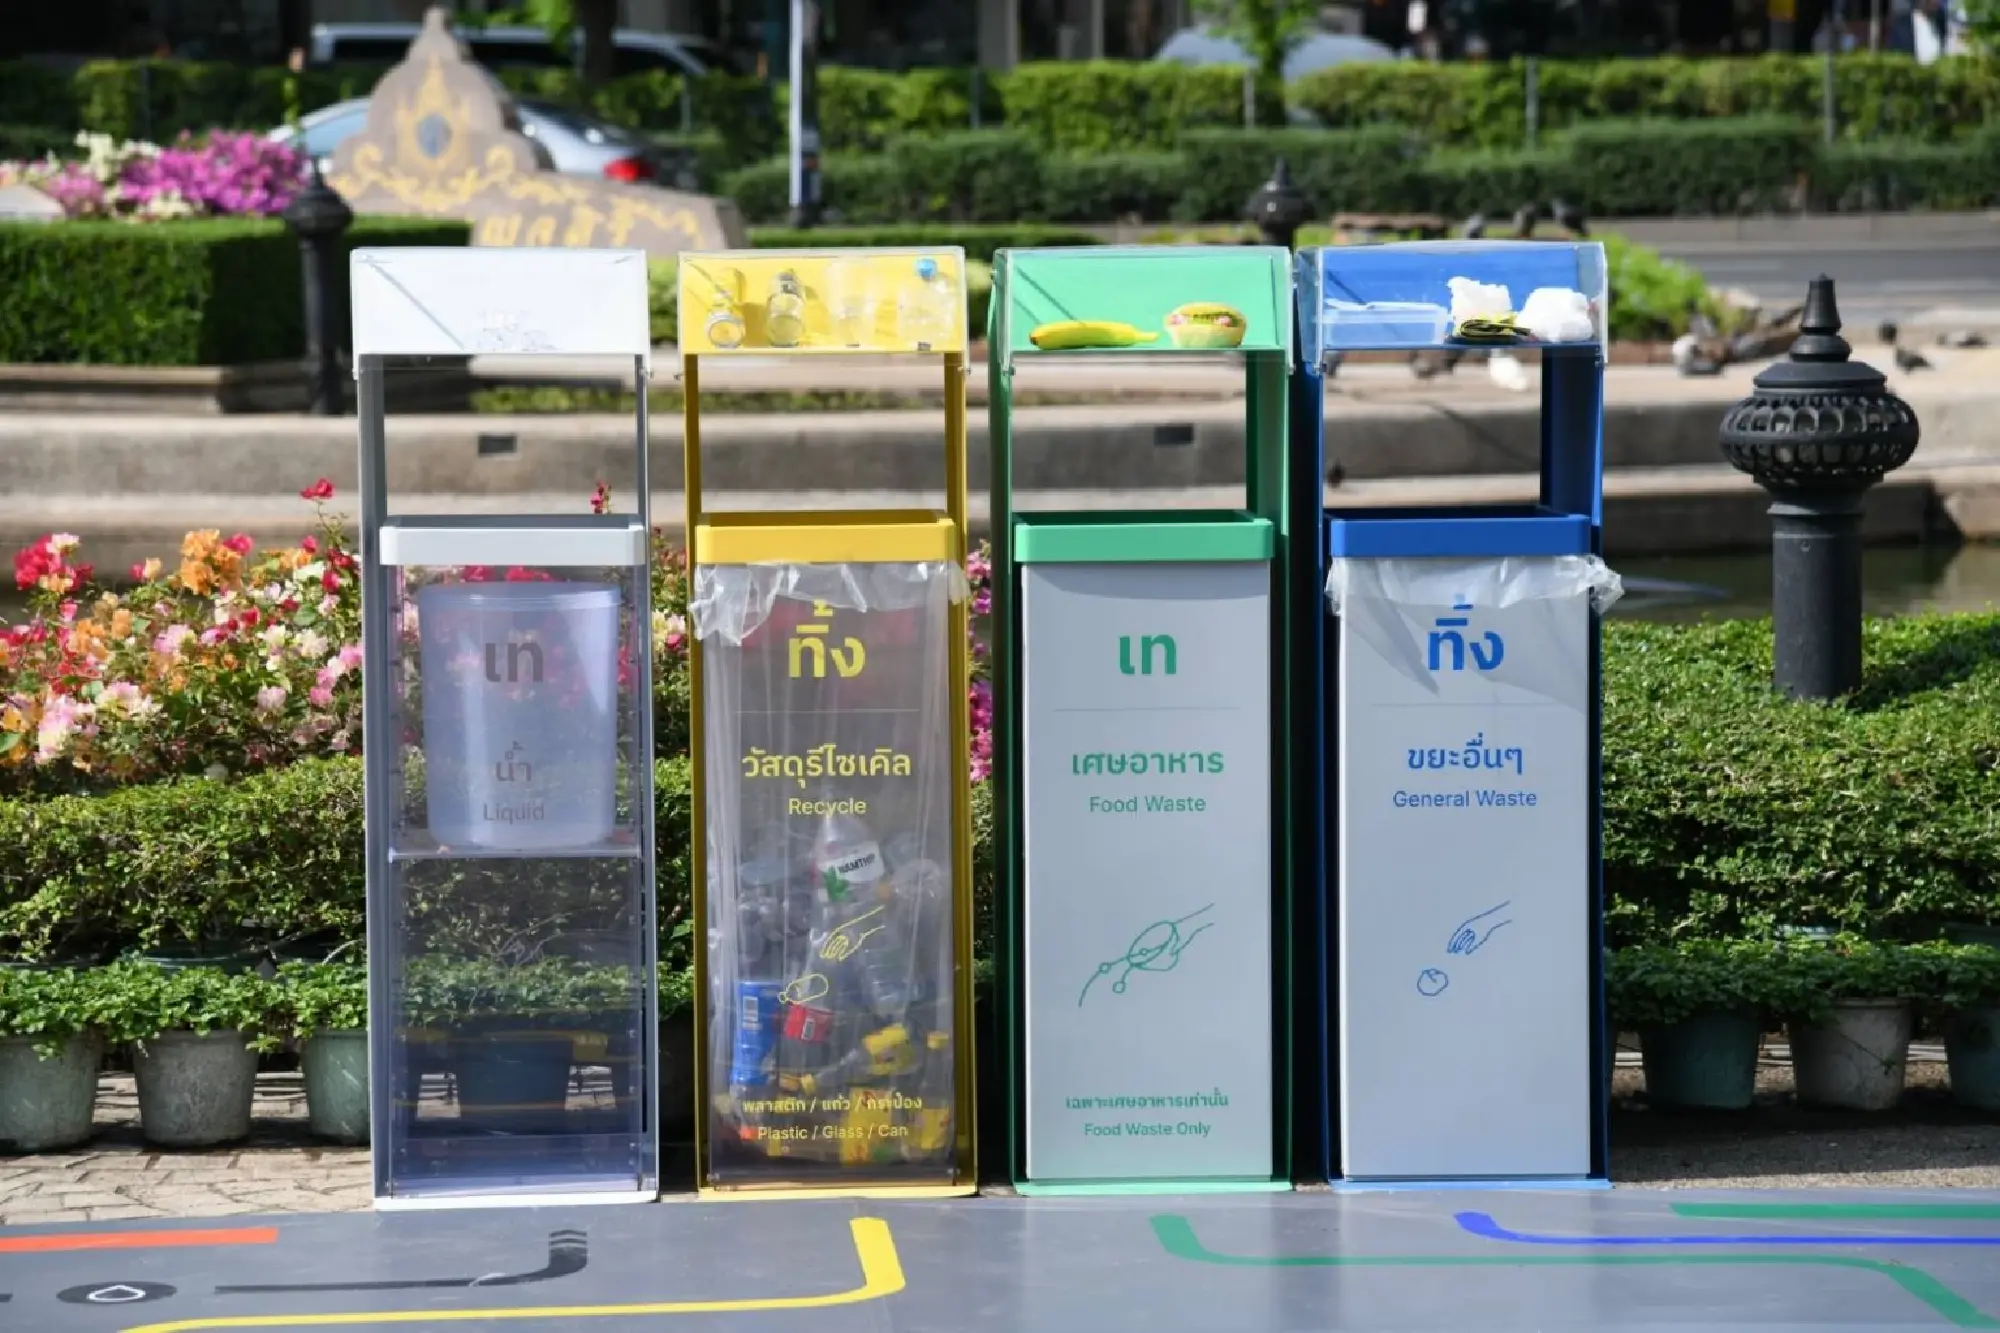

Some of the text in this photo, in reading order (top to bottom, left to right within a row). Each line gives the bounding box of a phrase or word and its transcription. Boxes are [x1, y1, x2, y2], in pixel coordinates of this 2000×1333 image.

[787, 599, 866, 678] ทิ้ง
[484, 641, 544, 683] เท
[1118, 633, 1177, 676] เท
[1071, 750, 1225, 776] เศษอาหาร
[1407, 732, 1523, 775] ขยะอื่นๆ
[741, 743, 912, 789] วัสดุรีไซเคิล
[788, 797, 867, 819] Recycle
[1089, 795, 1207, 813] Food Waste
[1392, 789, 1537, 808] General Waste
[483, 803, 545, 825] Liquid
[757, 1126, 808, 1140] Plastic
[822, 1125, 864, 1139] Glass
[878, 1124, 909, 1137] Can
[1084, 1121, 1211, 1138] Food Waste Only
